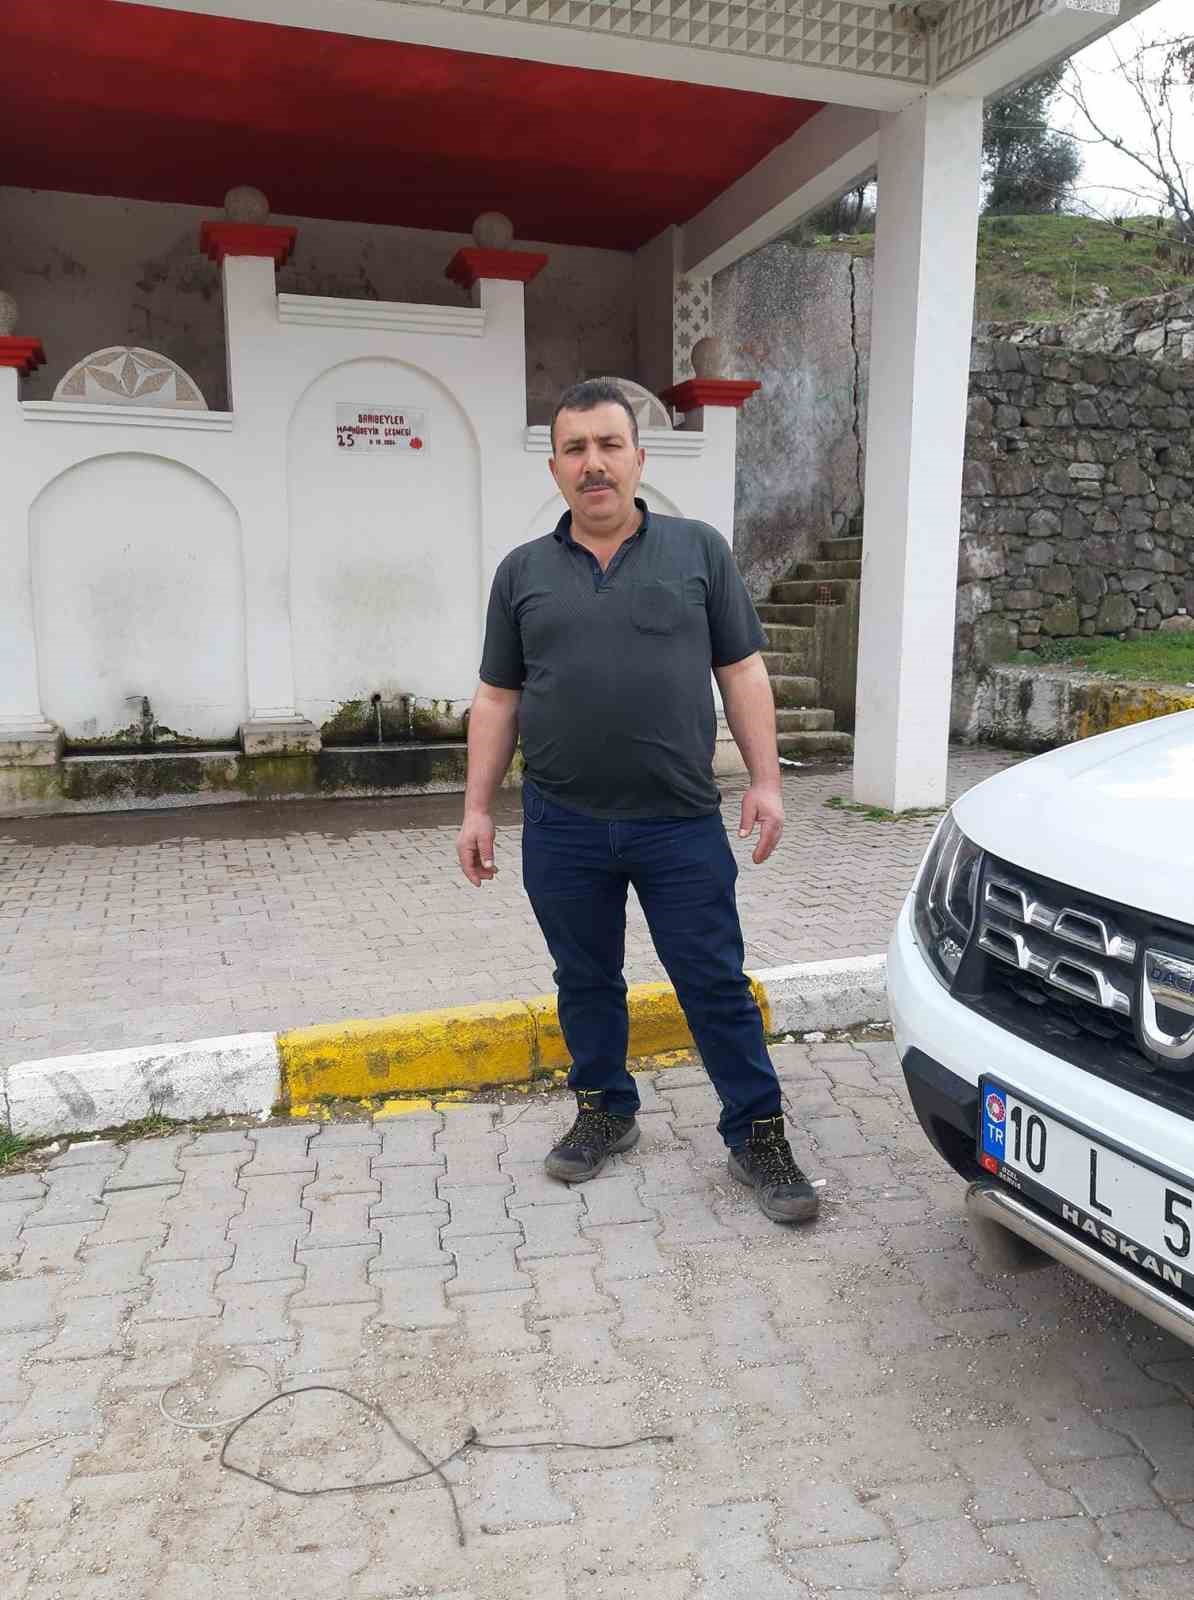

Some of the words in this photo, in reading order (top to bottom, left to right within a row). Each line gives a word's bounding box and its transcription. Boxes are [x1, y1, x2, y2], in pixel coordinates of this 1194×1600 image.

[987, 1123, 1004, 1145] TR
[1011, 1106, 1047, 1173] 10
[1090, 1148, 1112, 1217] L
[1163, 1188, 1192, 1258] 5
[1062, 1203, 1184, 1288] HASKAN
